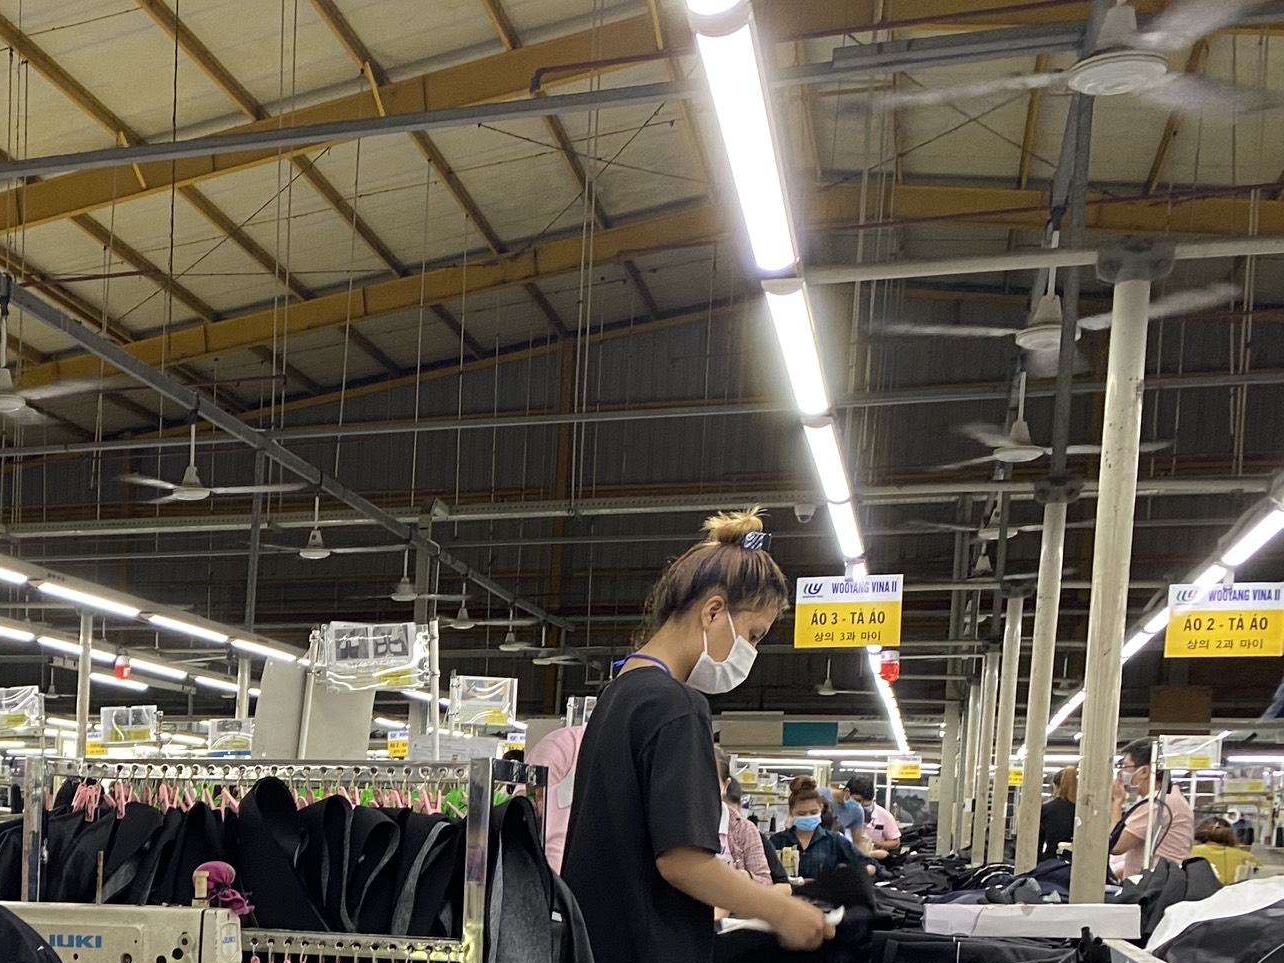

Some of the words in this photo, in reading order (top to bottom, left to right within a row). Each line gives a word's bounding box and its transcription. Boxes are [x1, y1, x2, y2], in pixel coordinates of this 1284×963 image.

[832, 581, 869, 594] WOOYANG
[872, 581, 889, 593] VINA
[892, 581, 897, 592] II
[1209, 589, 1250, 601] WOOYANG
[1252, 589, 1272, 601] VINA
[1274, 589, 1280, 600] II
[811, 609, 827, 625] ÁO
[831, 612, 838, 624] 3
[850, 608, 864, 624] TÀ
[869, 608, 885, 624] ÁO
[1184, 615, 1202, 631] ÁO
[1207, 618, 1214, 630] 2
[1250, 614, 1268, 630] ÁO
[814, 632, 834, 642] 상의
[840, 631, 855, 641] 3과
[861, 631, 881, 641] 마이
[1187, 640, 1209, 650] 상의
[1216, 639, 1233, 649] 2과
[1240, 639, 1263, 649] 마이
